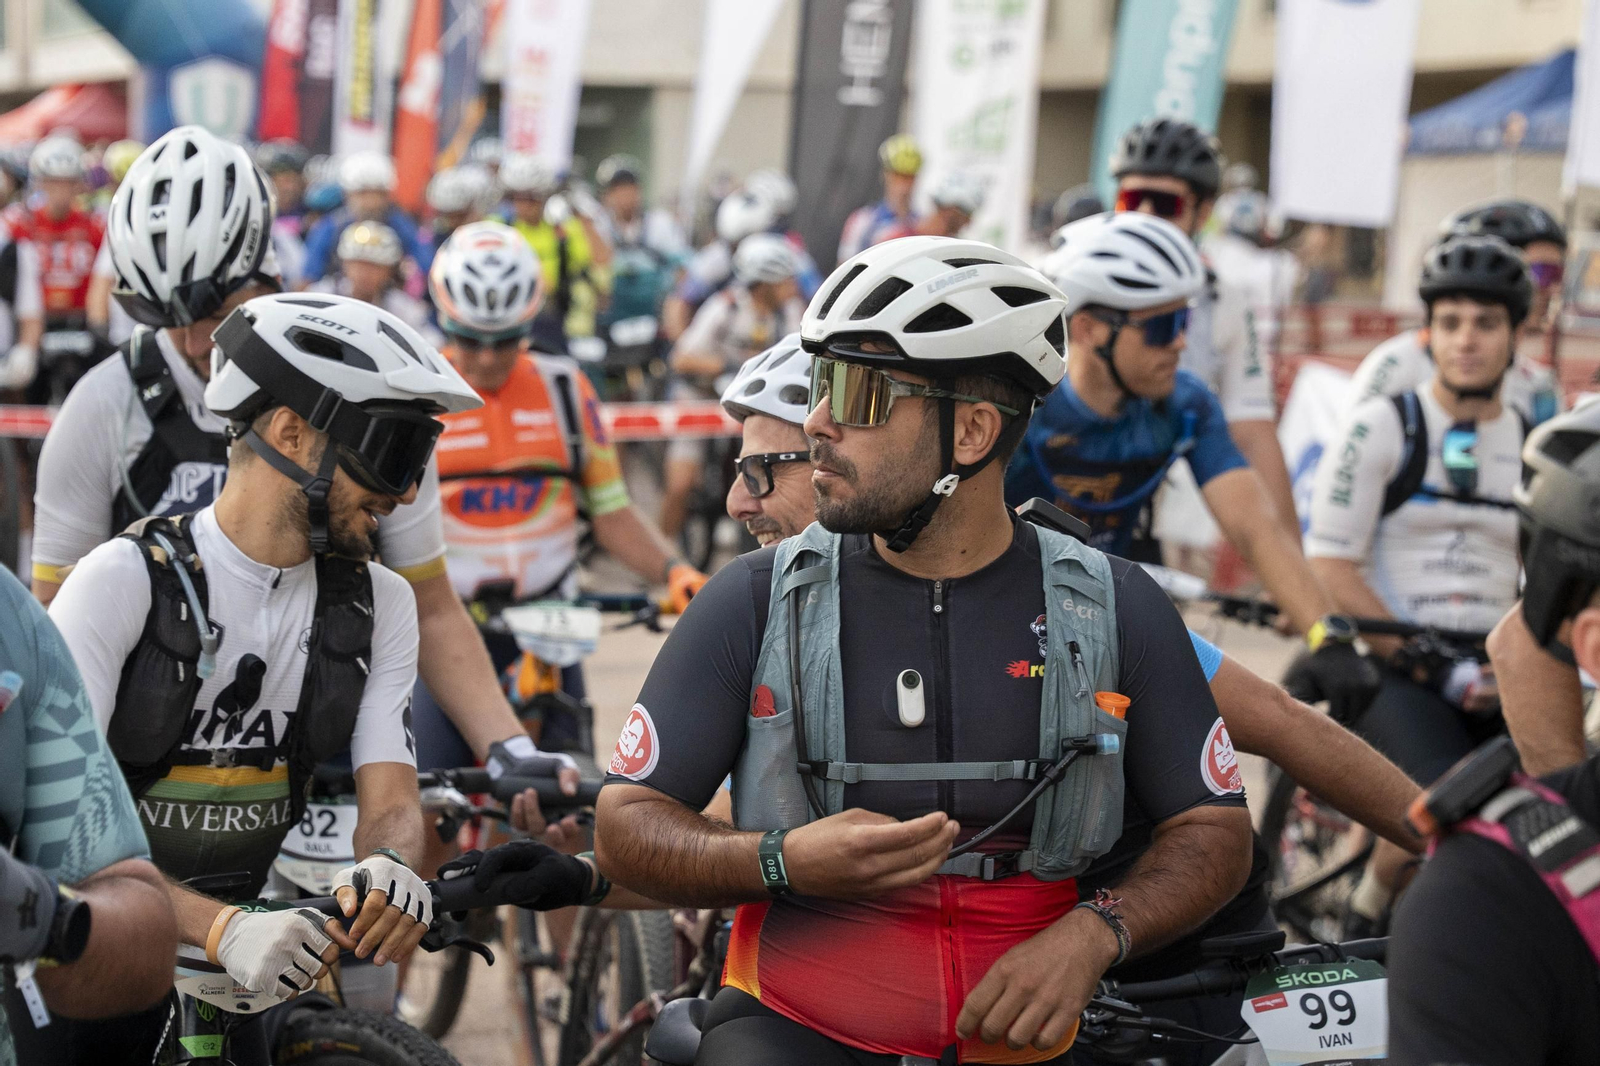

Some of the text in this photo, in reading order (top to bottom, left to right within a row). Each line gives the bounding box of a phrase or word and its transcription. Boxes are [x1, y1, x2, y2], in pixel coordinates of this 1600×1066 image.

[296, 313, 361, 336] SCOTT
[460, 474, 546, 514] KH7
[300, 810, 339, 837] 82
[1299, 989, 1357, 1030] 99
[1318, 1032, 1353, 1049] IVAN
